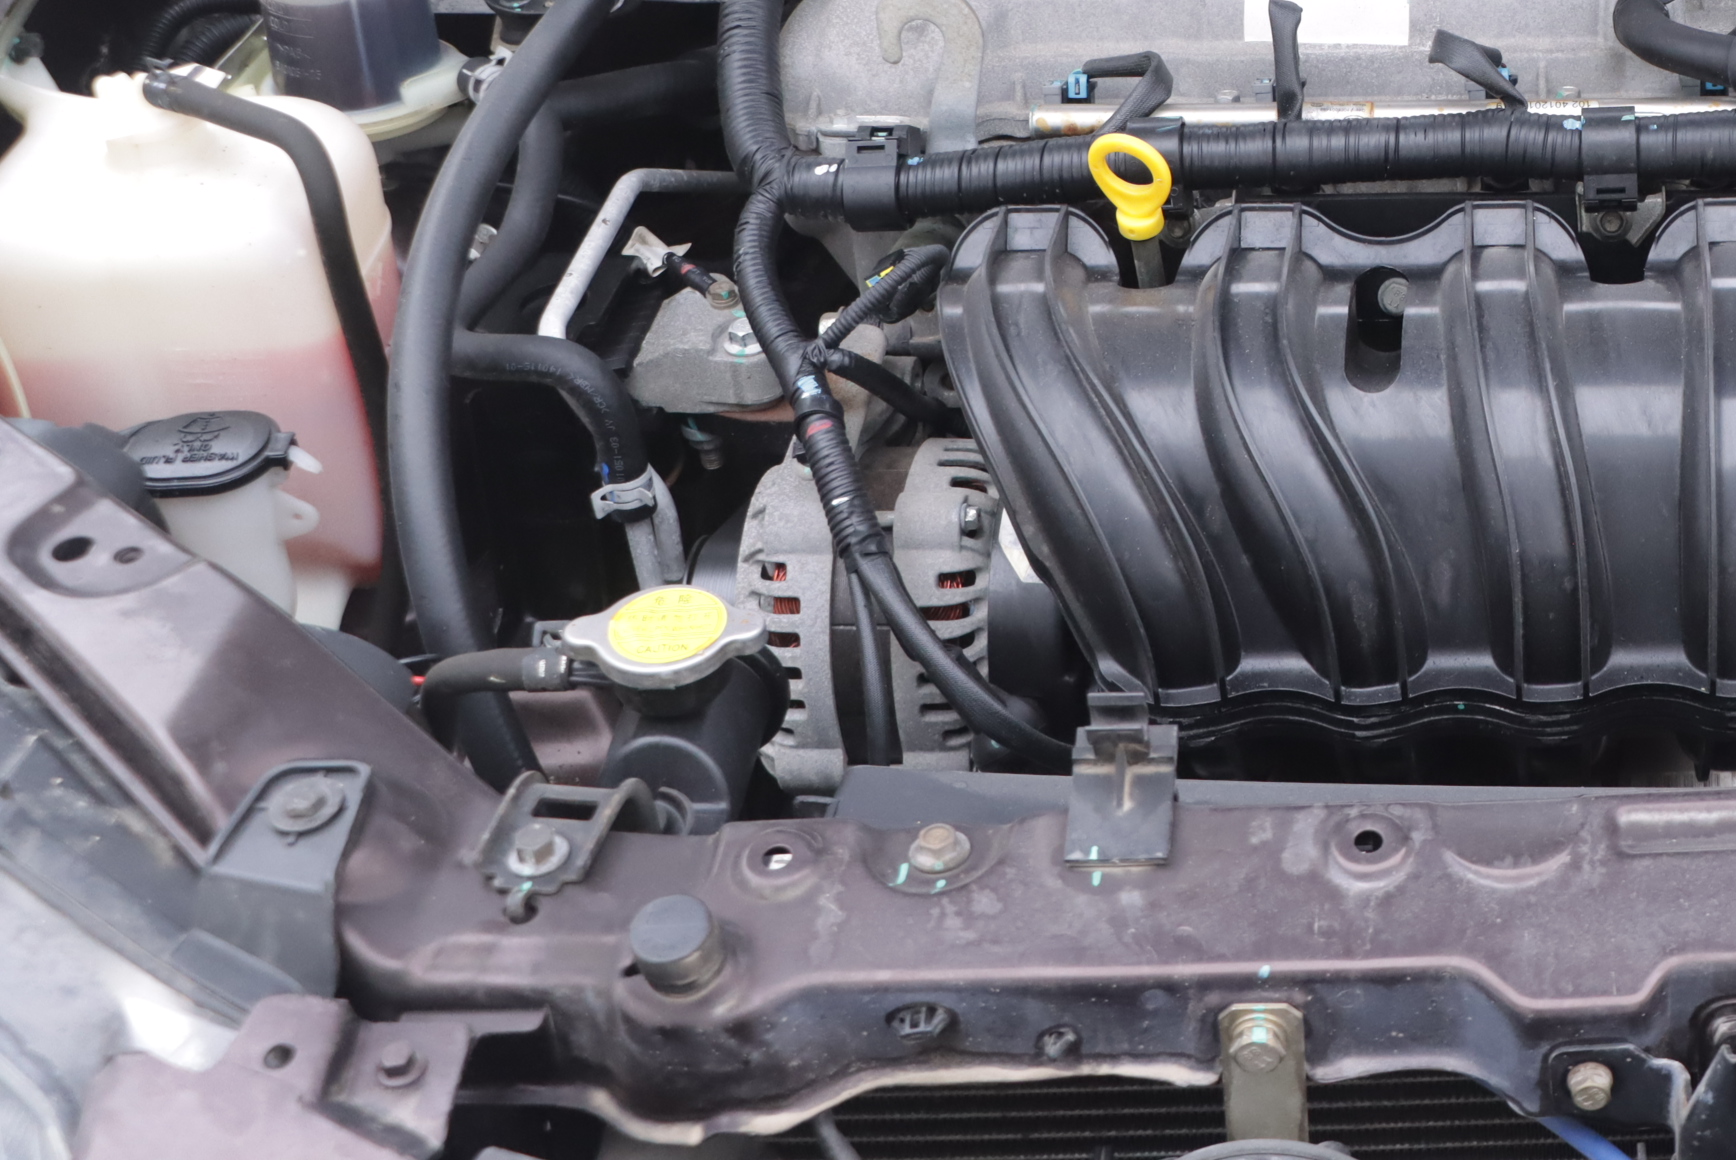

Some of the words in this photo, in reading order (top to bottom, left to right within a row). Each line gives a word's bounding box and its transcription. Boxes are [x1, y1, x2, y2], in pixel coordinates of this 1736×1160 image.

[172, 442, 213, 454] ONLY
[139, 454, 178, 465] FLUID
[181, 451, 240, 464] WASHER
[636, 643, 689, 654] CAUTION
